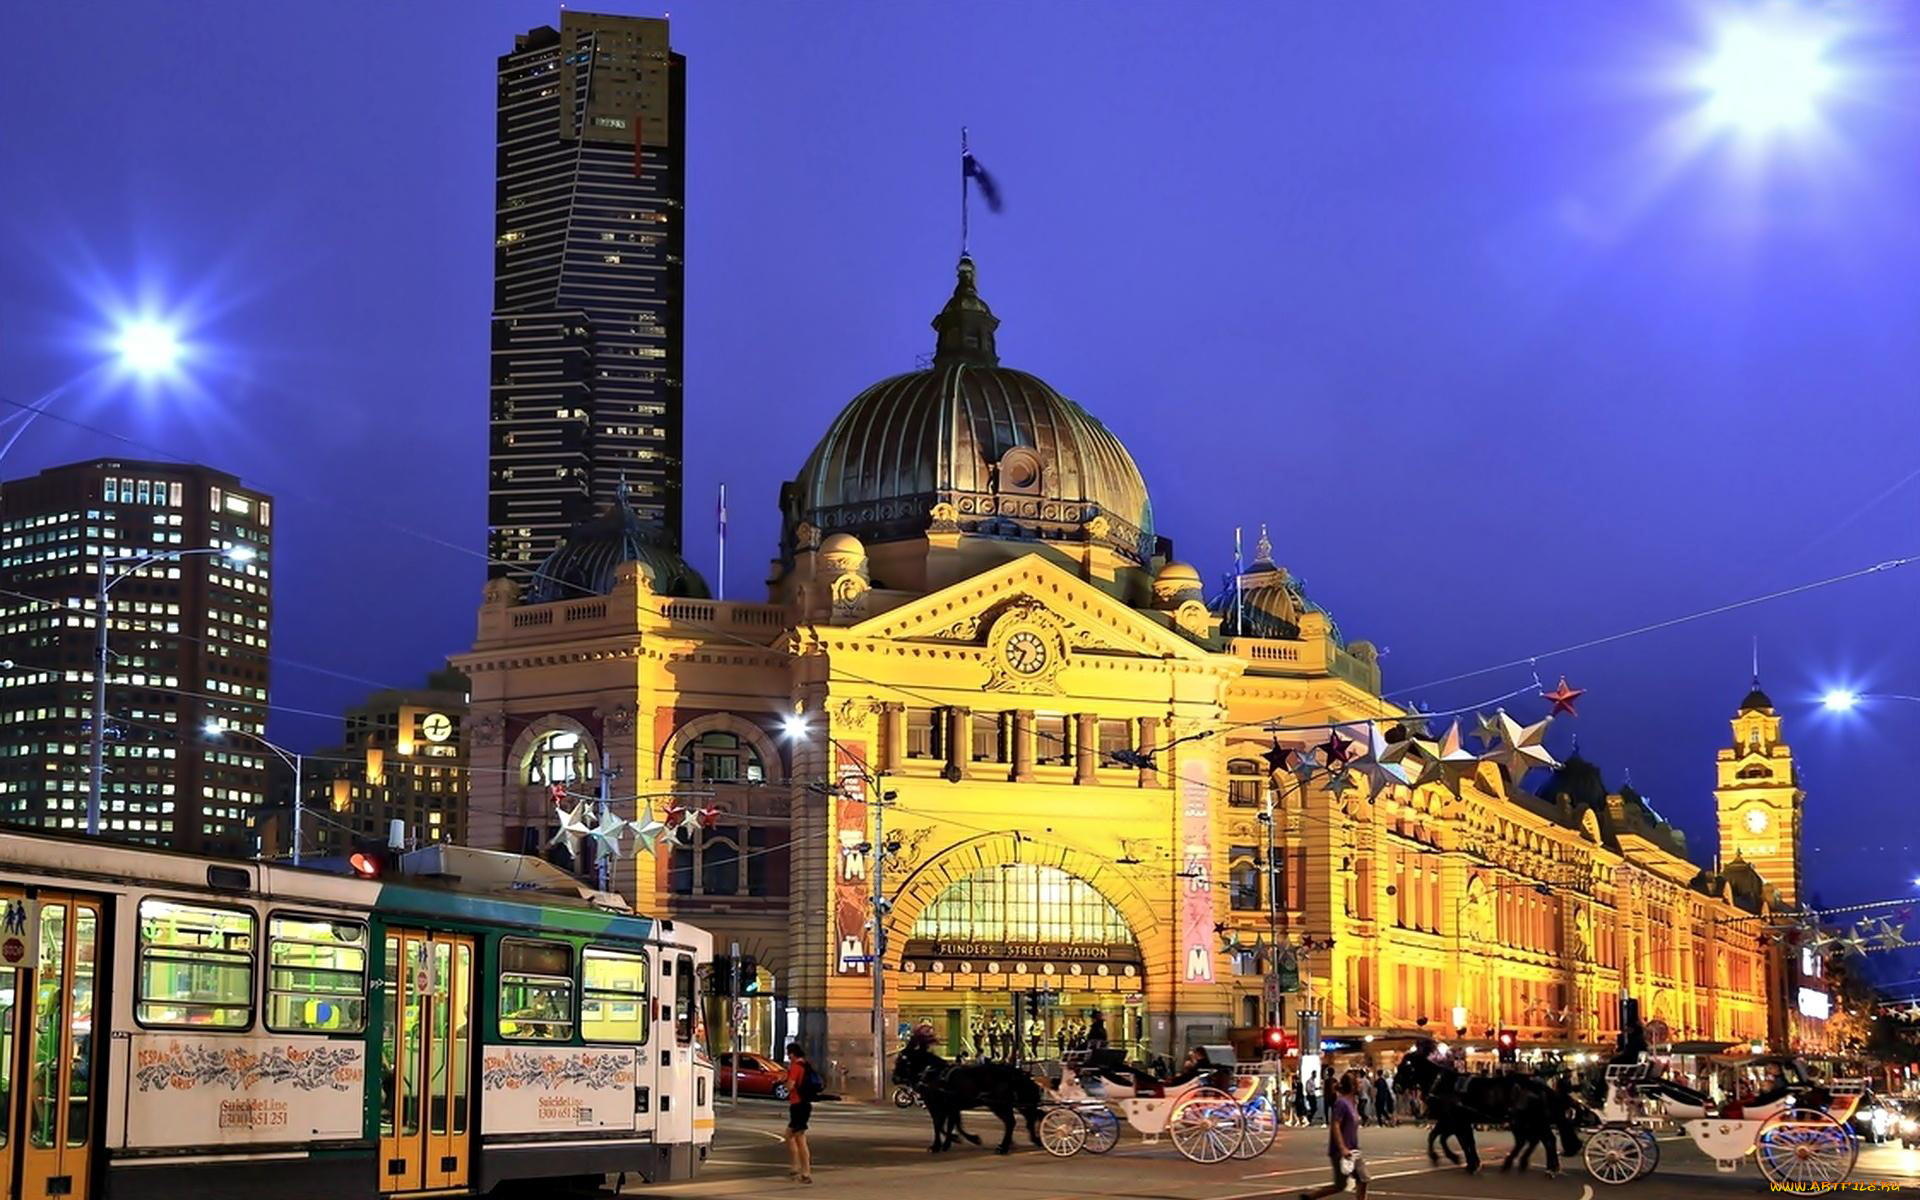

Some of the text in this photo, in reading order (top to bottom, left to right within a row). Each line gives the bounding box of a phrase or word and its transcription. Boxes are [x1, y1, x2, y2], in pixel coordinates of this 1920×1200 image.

[939, 943, 1109, 959] FLINDERS STREET STATION
[221, 1098, 288, 1112] SuicideLine
[270, 1111, 288, 1125] 251
